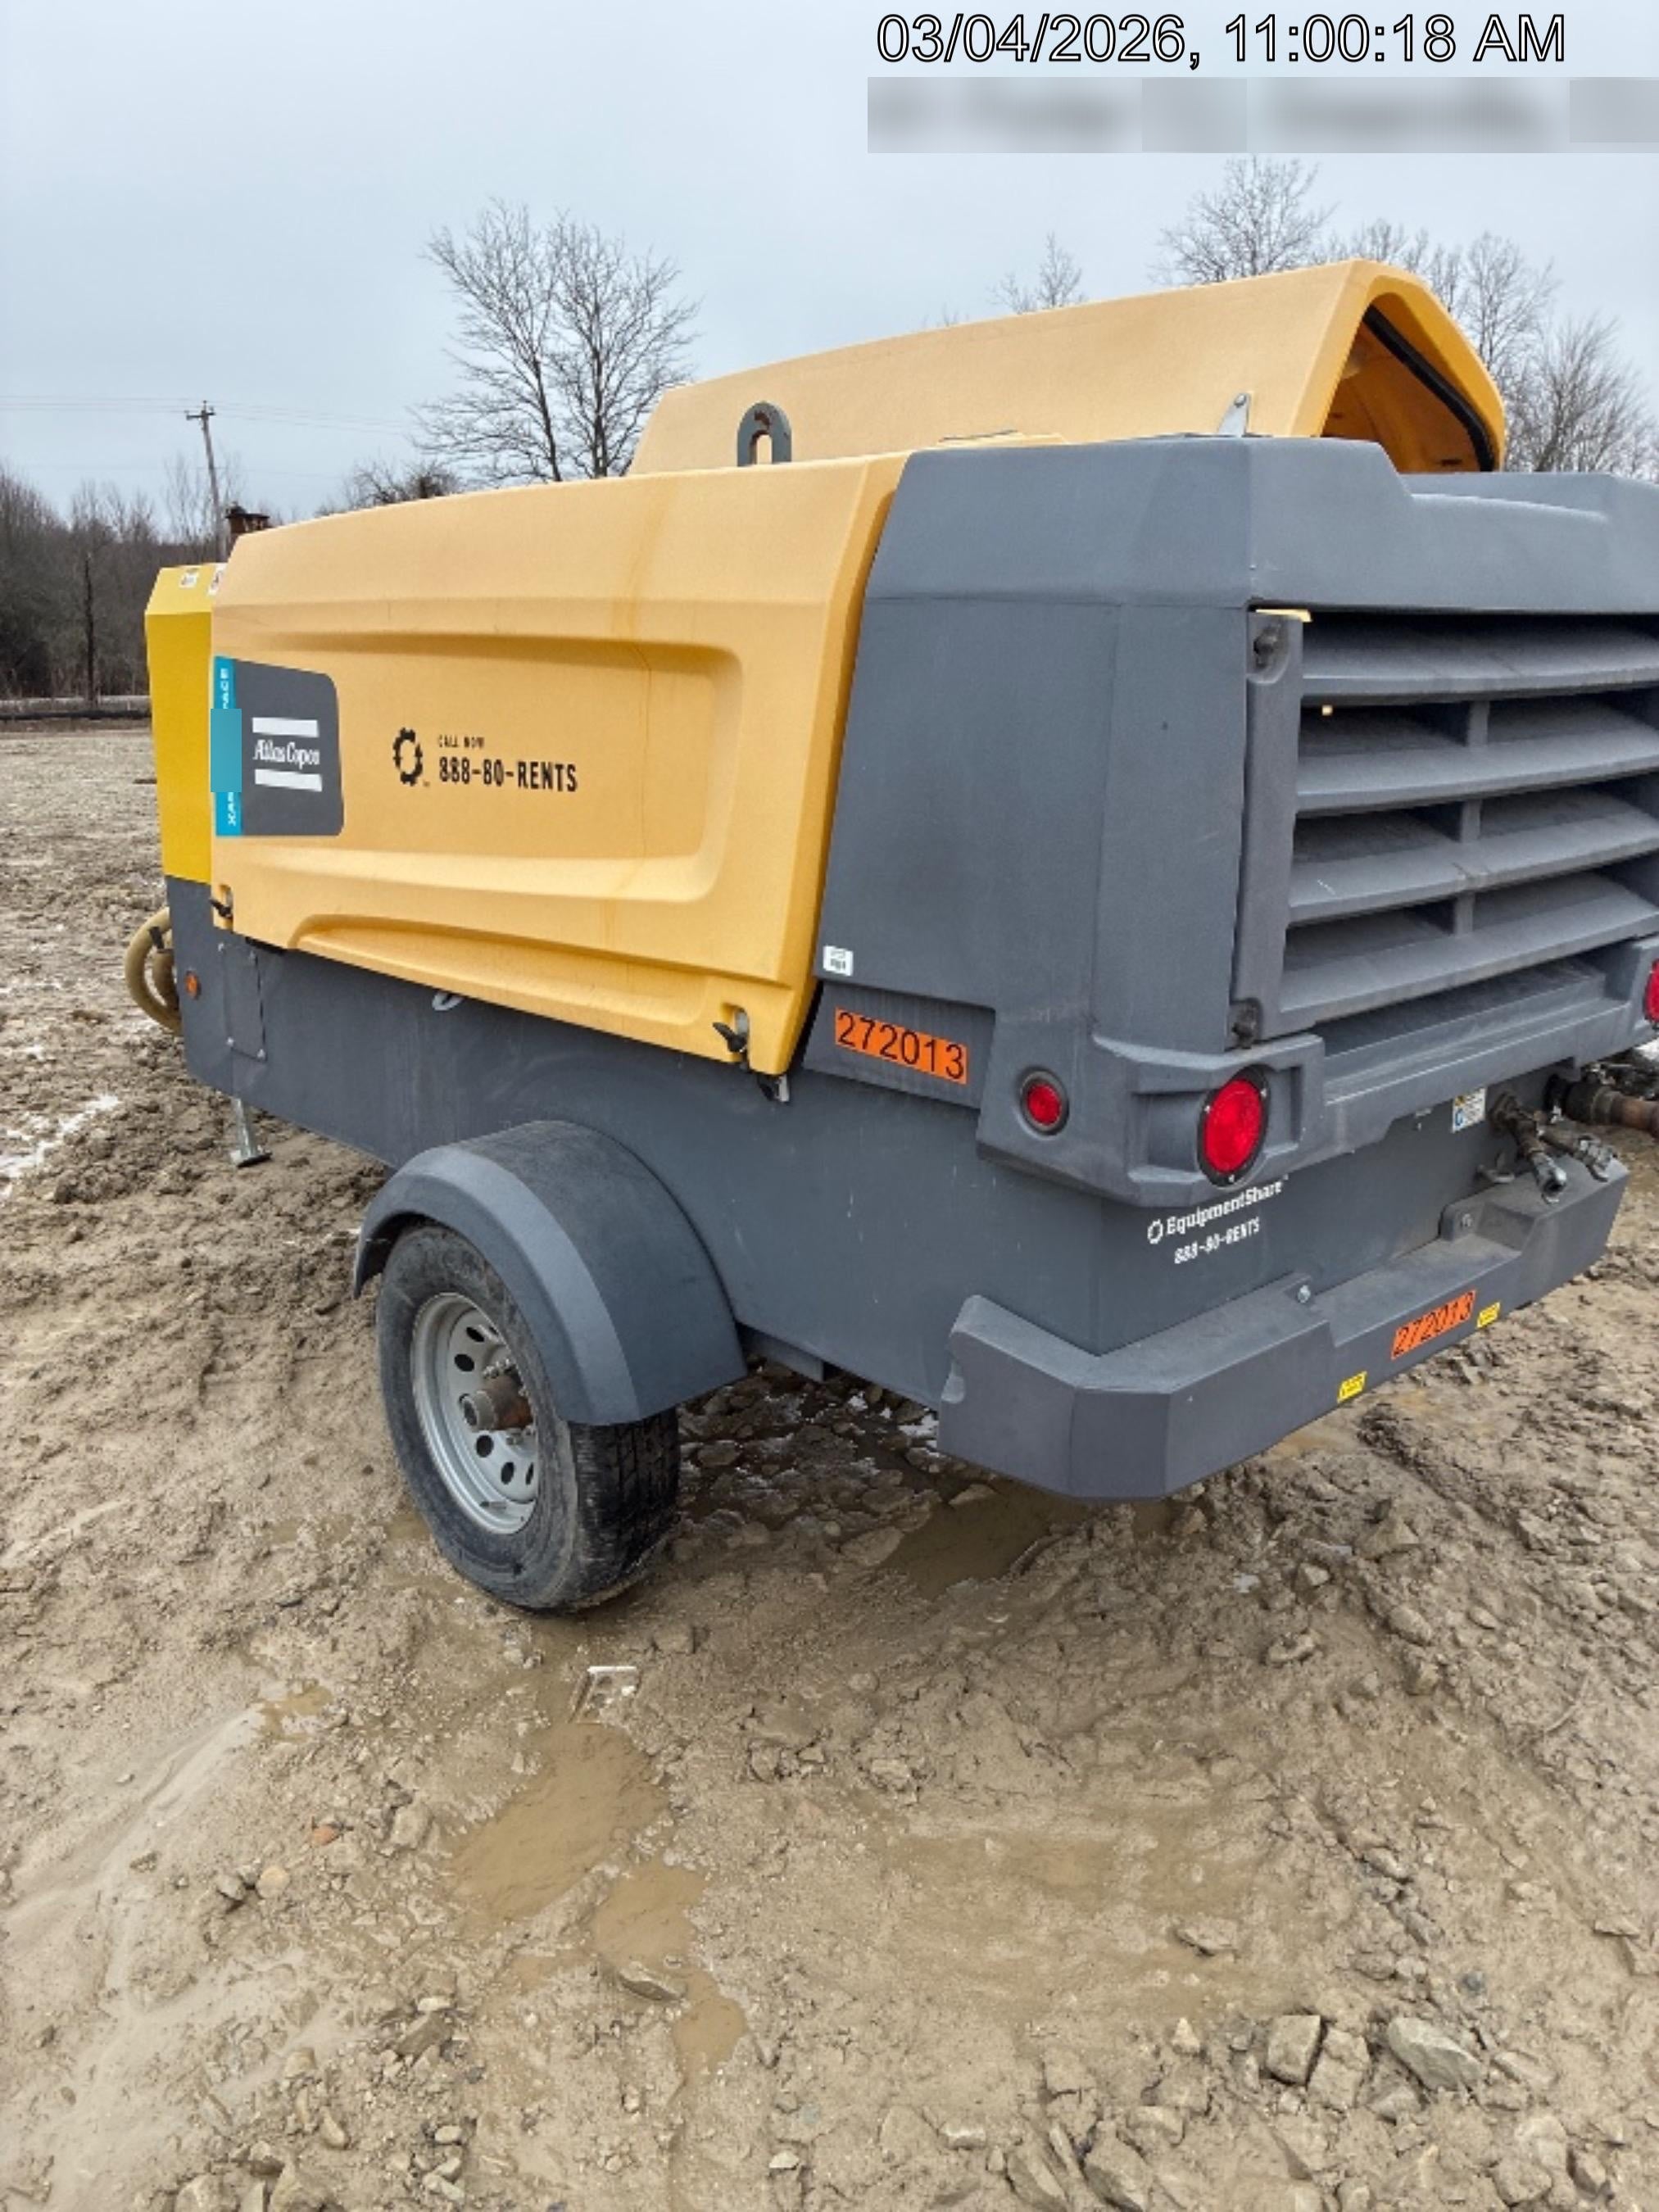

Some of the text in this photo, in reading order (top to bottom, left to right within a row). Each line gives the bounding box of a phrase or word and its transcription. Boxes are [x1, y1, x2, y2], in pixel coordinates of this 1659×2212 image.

[252, 739, 320, 770] Atlas Copco
[438, 734, 485, 750] CALL NOW
[439, 756, 578, 792] 888-80-RENTS
[837, 1012, 964, 1080] 272013
[1166, 1181, 1284, 1235] EquipmentShare
[1174, 1217, 1260, 1264] 888-80-RENTS
[1394, 1291, 1473, 1358] 272013
